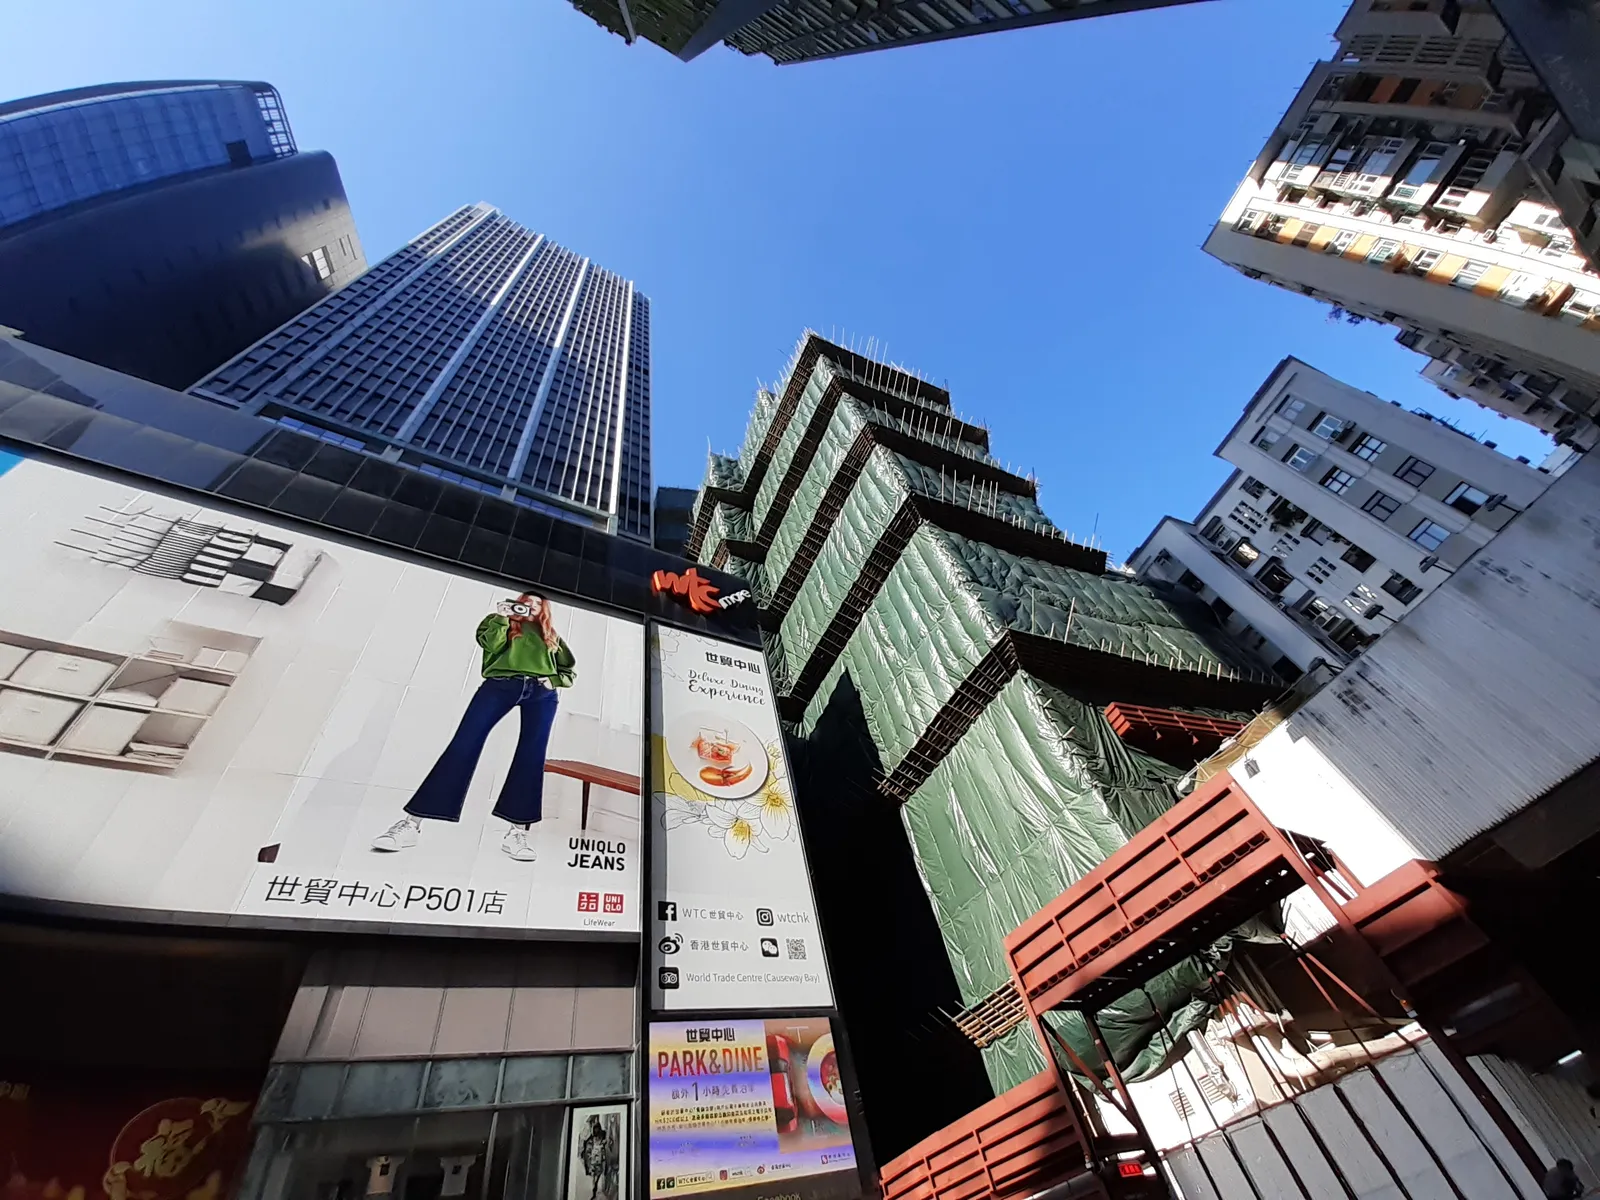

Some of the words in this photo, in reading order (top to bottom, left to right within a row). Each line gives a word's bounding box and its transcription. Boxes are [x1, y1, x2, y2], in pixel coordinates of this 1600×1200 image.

[705, 652, 761, 674] 世貿中心
[688, 669, 726, 686] Deluxe
[730, 679, 765, 696] Dining
[688, 679, 766, 706] Experience
[569, 837, 626, 854] UNIQLO
[567, 854, 626, 871] JEANS
[583, 918, 615, 926] LifeWear
[777, 912, 811, 924] wtchk
[690, 939, 749, 951] 香港世貿中心
[686, 973, 711, 983] World
[713, 974, 736, 983] Trade
[737, 973, 763, 983] Centre
[764, 973, 803, 984] (Causeway
[804, 973, 820, 984] Bay)
[686, 1027, 736, 1043] 世貿中心
[657, 1046, 765, 1078] PARK&DINE
